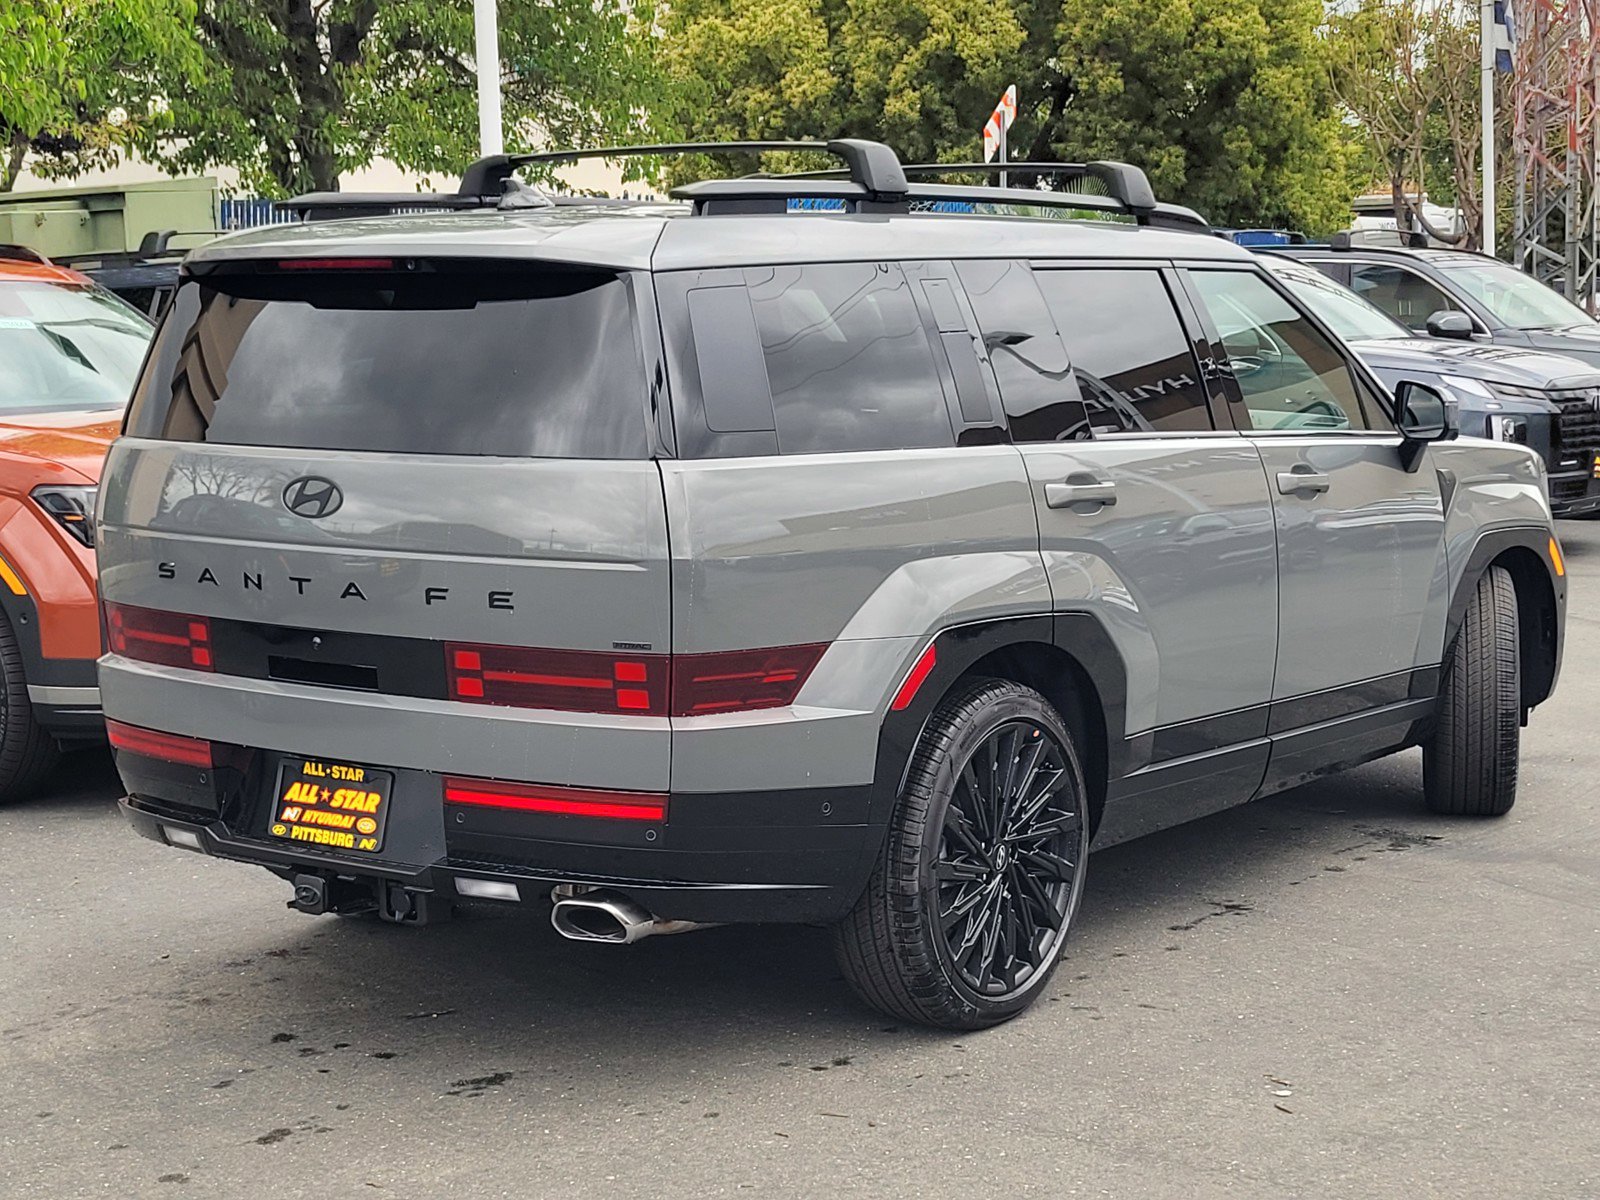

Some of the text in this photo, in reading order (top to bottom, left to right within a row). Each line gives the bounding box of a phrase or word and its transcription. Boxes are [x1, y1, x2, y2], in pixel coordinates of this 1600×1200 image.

[158, 562, 514, 610] SANTA FE
[303, 762, 364, 782] ALL STAR
[283, 782, 381, 813] ALL STAR
[302, 810, 356, 829] HYUNDAI
[291, 825, 354, 848] PITTSBURG
